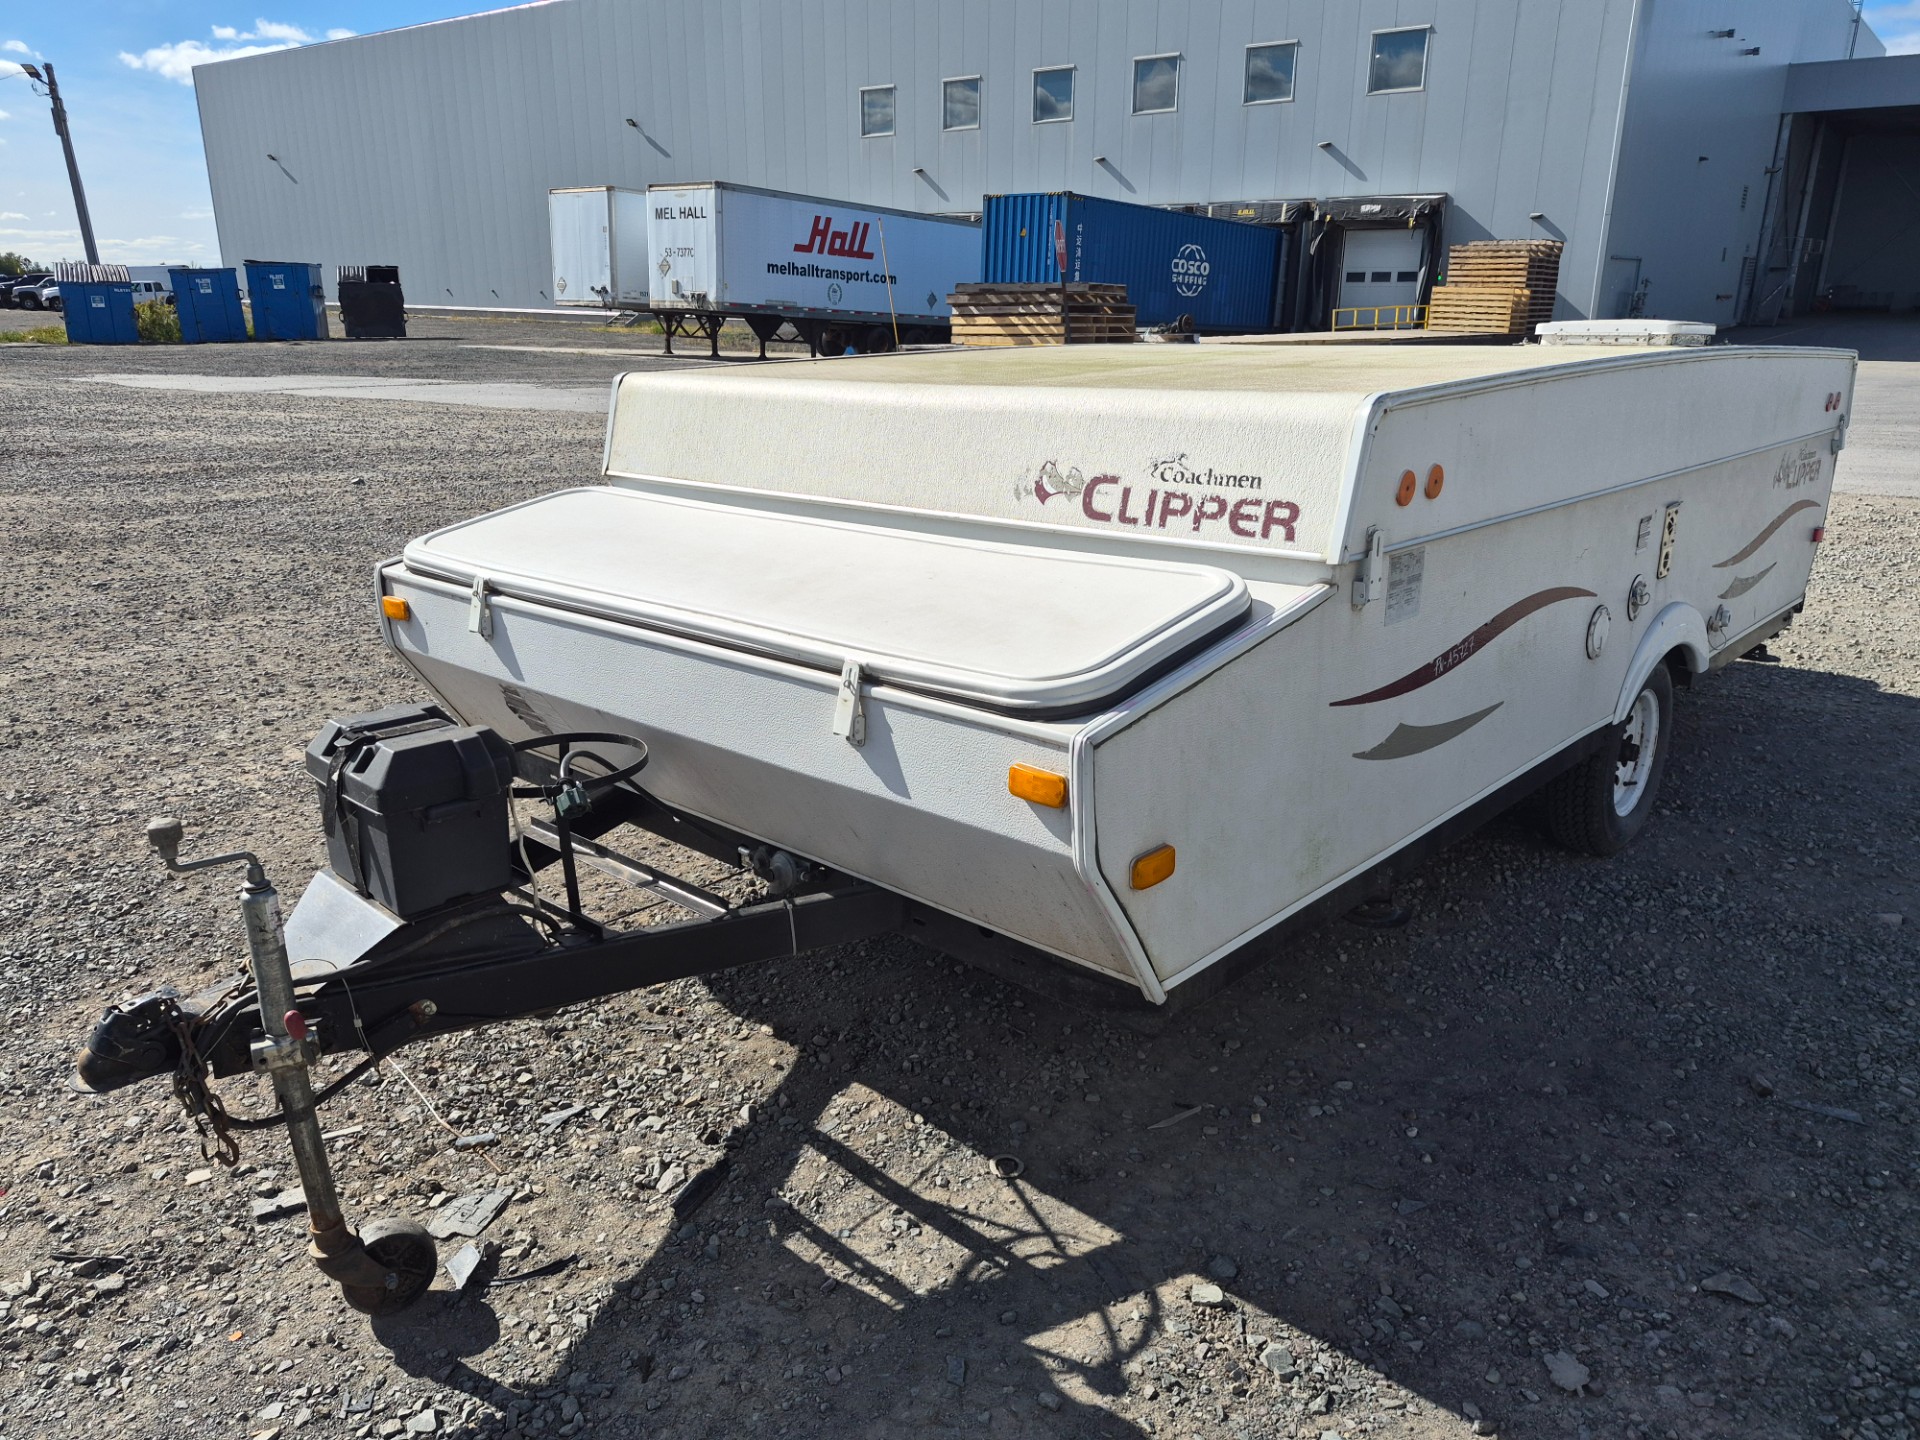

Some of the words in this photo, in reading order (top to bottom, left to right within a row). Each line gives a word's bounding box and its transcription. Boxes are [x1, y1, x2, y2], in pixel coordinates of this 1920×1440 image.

[655, 207, 677, 220] MEL
[679, 206, 707, 219] HALL
[793, 215, 874, 260] Hall
[767, 261, 897, 285] melhalltransport.com
[1171, 258, 1210, 276] COSCO
[1171, 273, 1207, 286] SHPPING
[1160, 466, 1262, 490] Coachmen
[1082, 474, 1300, 542] CLIPPER
